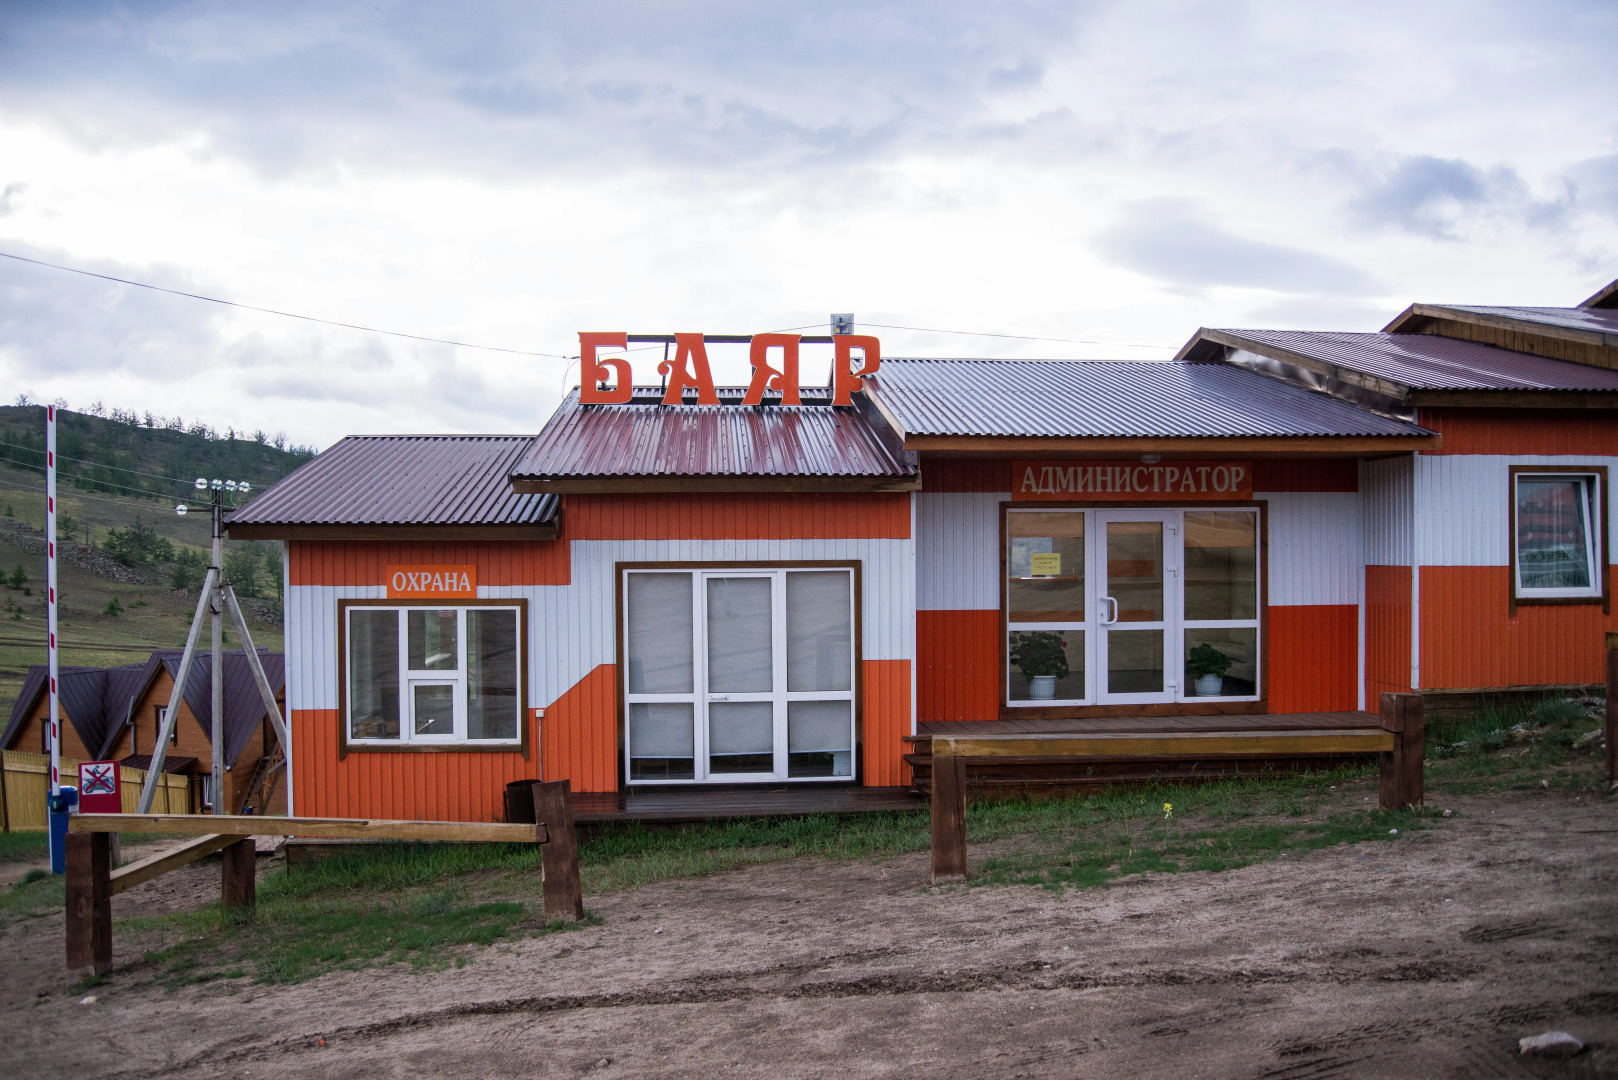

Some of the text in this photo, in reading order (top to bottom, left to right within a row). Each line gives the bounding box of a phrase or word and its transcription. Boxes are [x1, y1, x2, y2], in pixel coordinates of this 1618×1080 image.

[577, 332, 880, 406] БАЯР
[1021, 466, 1245, 494] АДМИНИСТРАТОР
[392, 572, 471, 591] ОХРАНА
